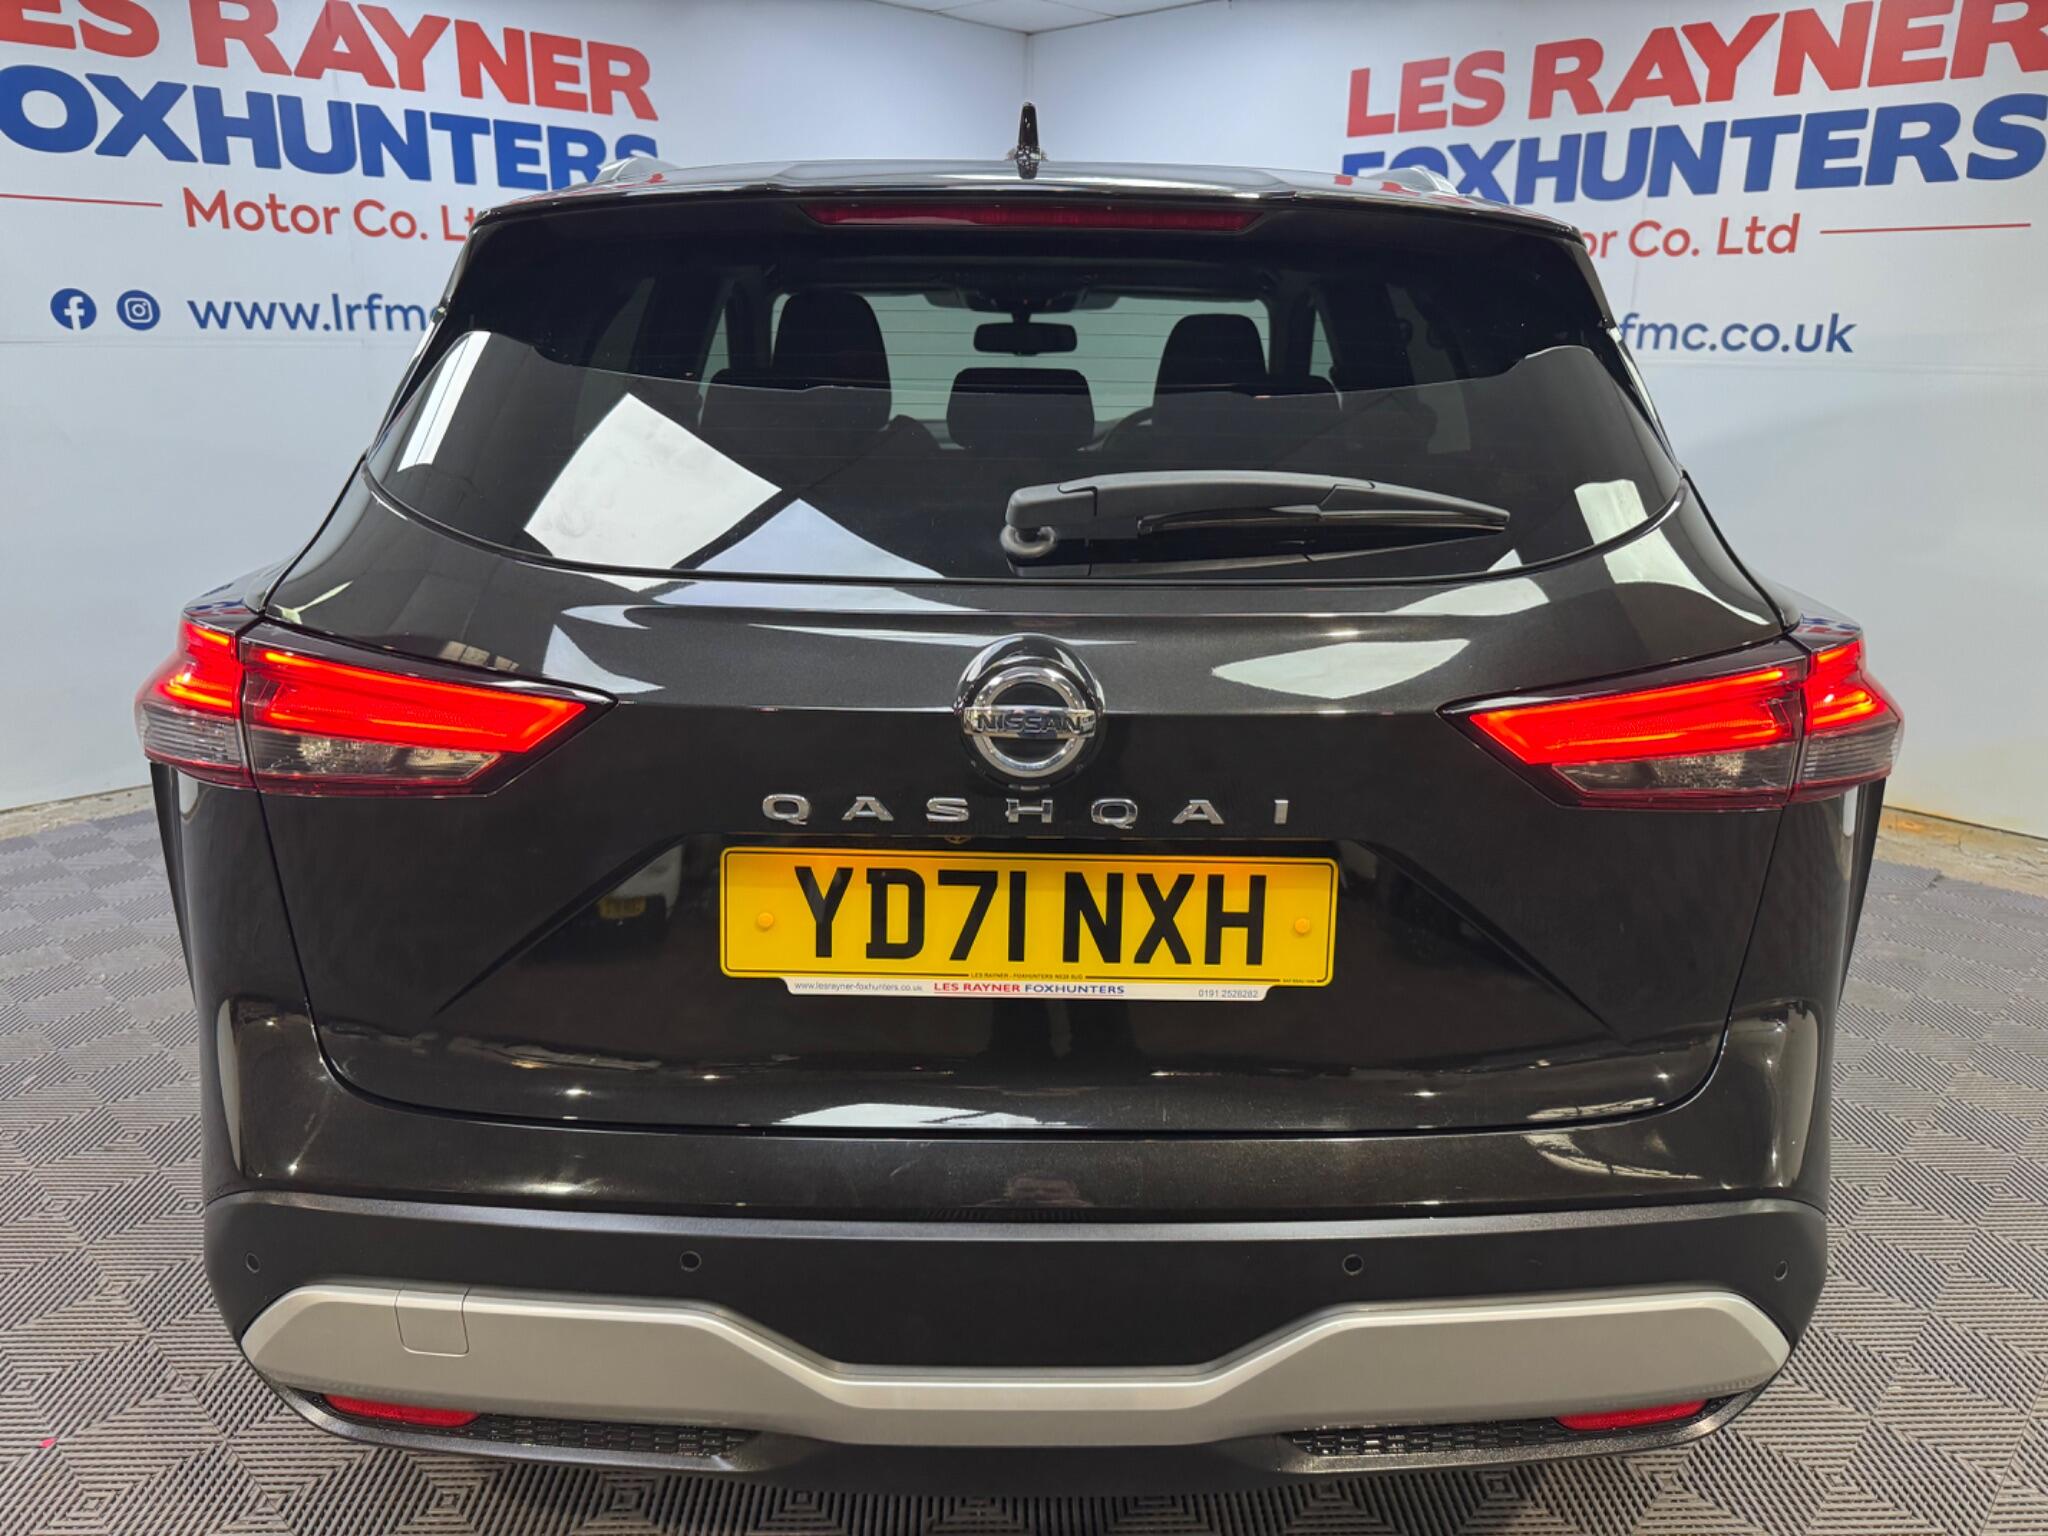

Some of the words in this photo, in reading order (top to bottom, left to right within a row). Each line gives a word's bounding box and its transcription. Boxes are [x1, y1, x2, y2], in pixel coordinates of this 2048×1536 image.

[0, 0, 160, 58] ES
[188, 0, 658, 121] RAYNER
[1346, 50, 1505, 138] LES
[1528, 0, 2048, 119] RAYNER
[0, 64, 658, 192] OXHUNTER
[182, 187, 340, 235] Motor
[353, 198, 429, 241] Co.
[1628, 220, 1700, 258] Co.
[1716, 212, 1801, 256] Ltd
[186, 293, 450, 332] www.lrfm
[1619, 312, 1857, 353] fmc.co.uk
[976, 714, 1080, 734] NISSAN
[762, 793, 1289, 830] QASHQAI
[794, 865, 1027, 962] YD71
[1062, 871, 1267, 966] NXH
[934, 982, 959, 992] LES
[963, 983, 1020, 993] RAYNER
[1025, 984, 1125, 994] FOXHUNTERS
[1198, 989, 1219, 998] 0191
